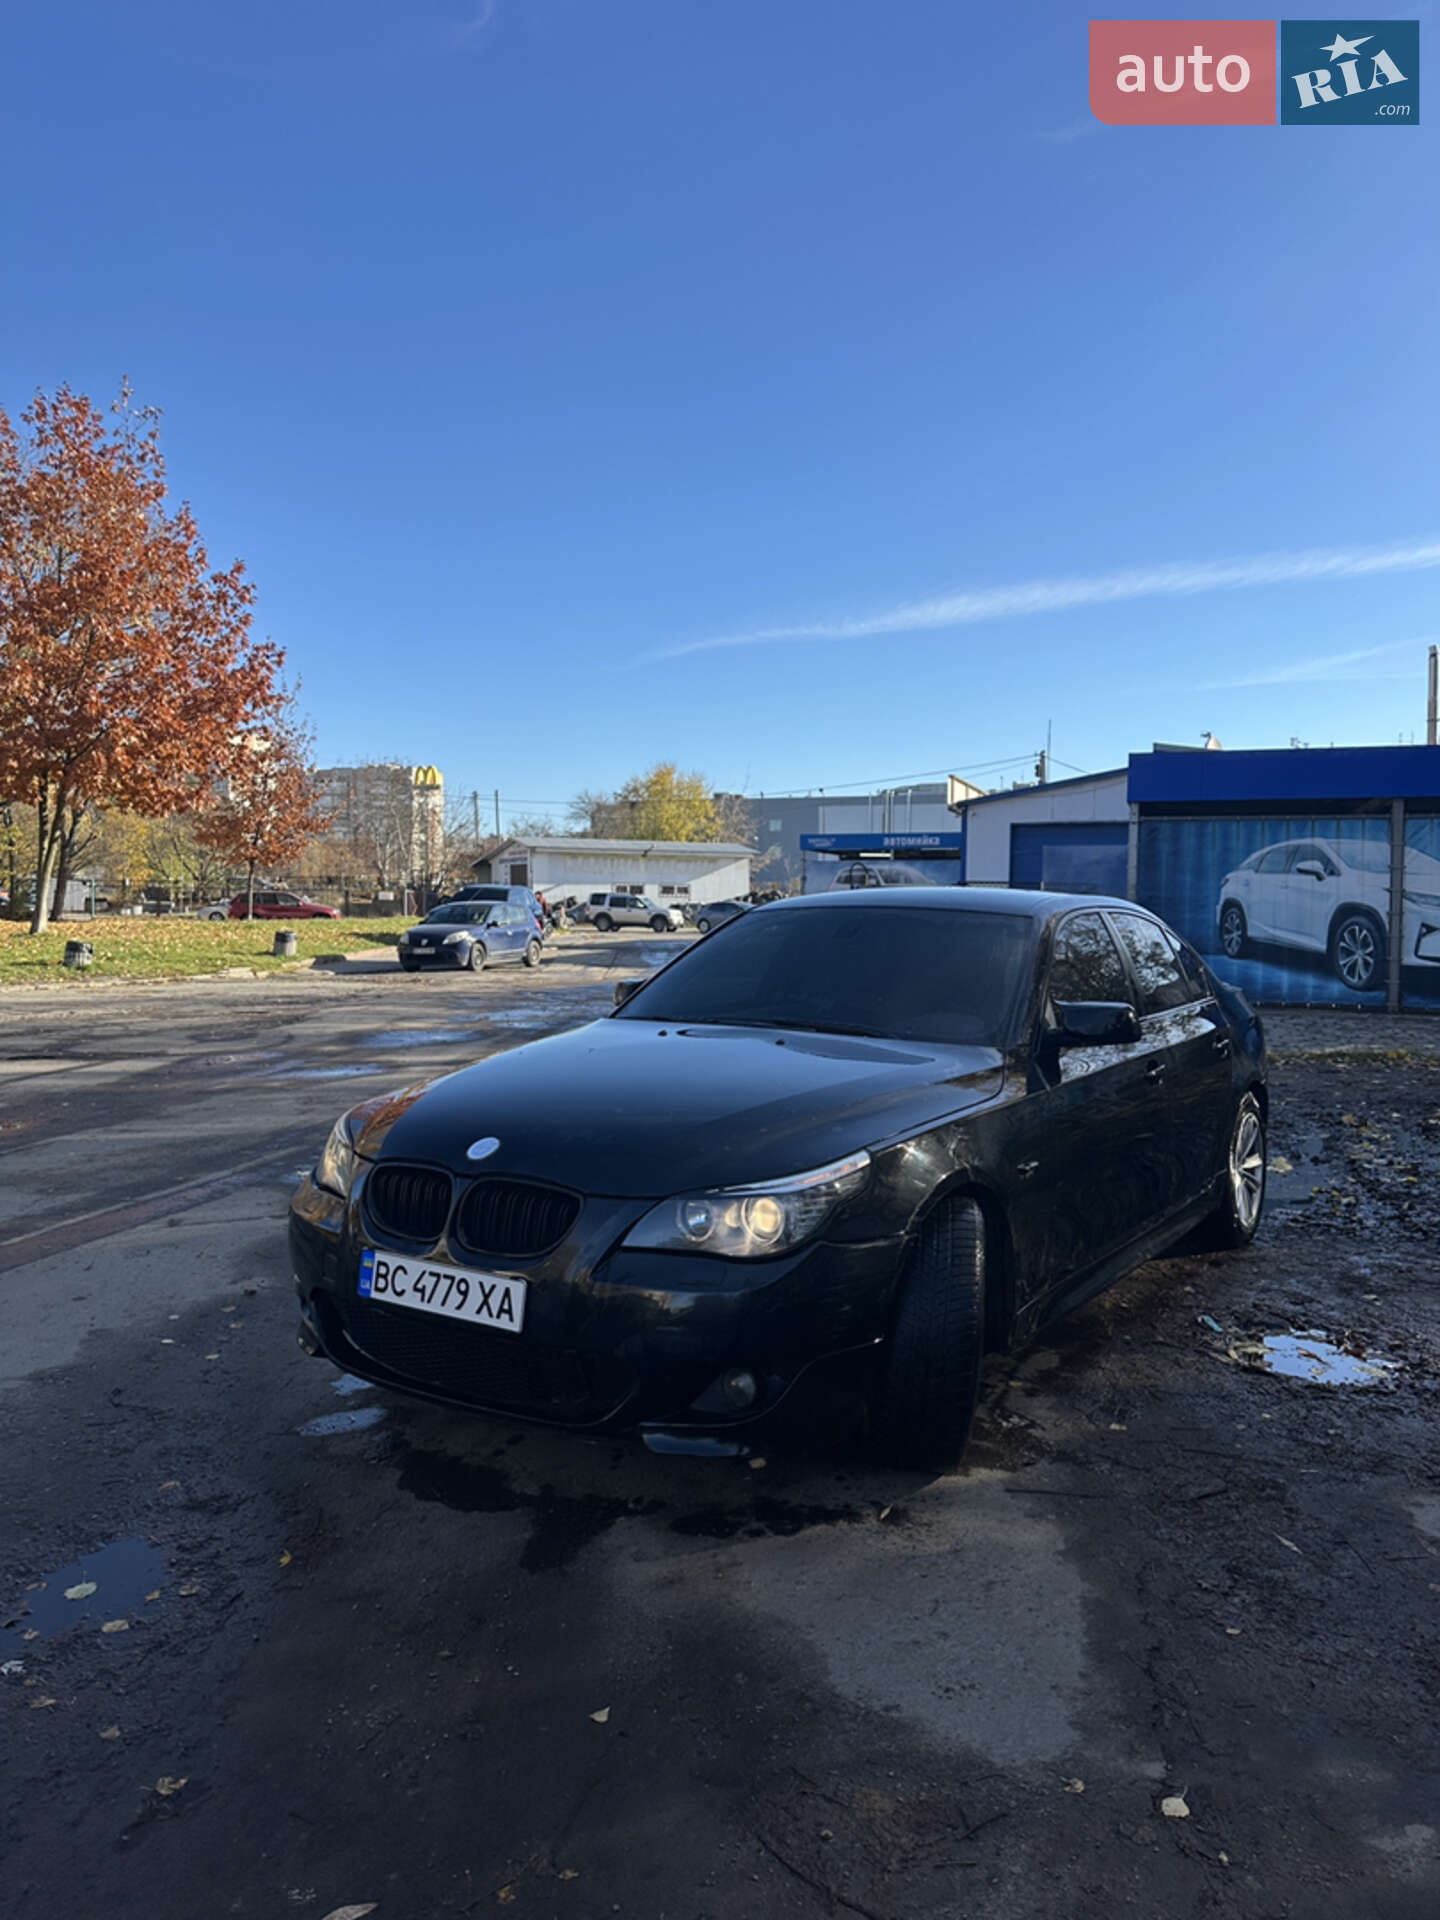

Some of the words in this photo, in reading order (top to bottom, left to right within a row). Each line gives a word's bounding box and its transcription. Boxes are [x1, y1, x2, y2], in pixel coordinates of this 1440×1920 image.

[374, 1261, 408, 1297] BC
[412, 1271, 471, 1311] 4779
[475, 1281, 515, 1323] XA
